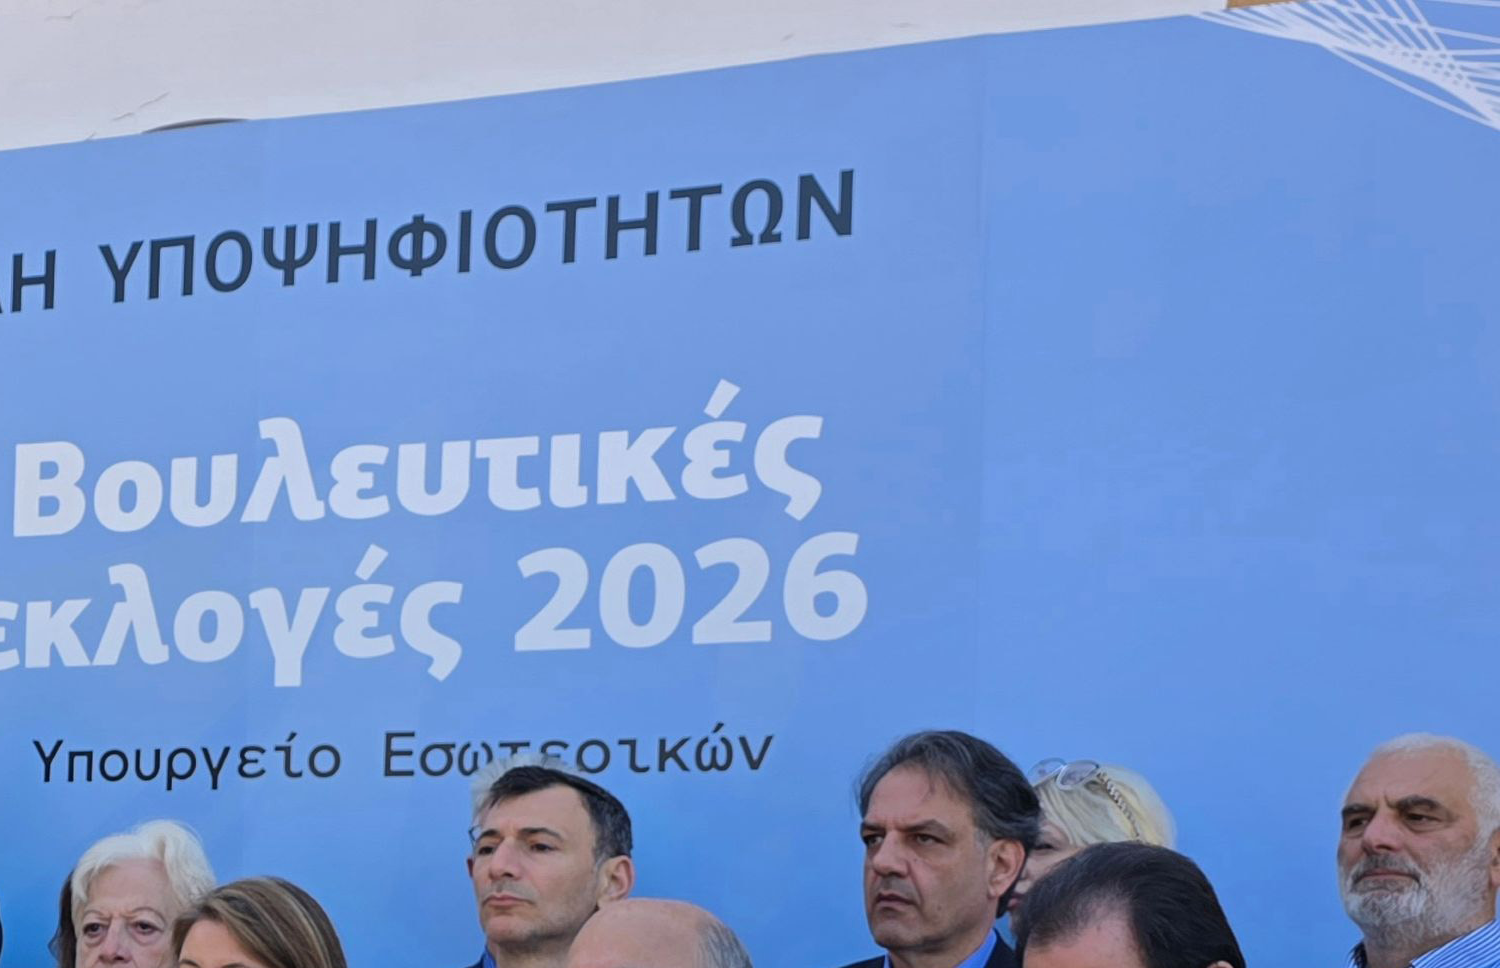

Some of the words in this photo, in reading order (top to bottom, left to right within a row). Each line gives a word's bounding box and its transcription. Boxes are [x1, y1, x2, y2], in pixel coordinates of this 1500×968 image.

[98, 168, 855, 304] ΥΠΟΨΗΦΙΟΤΗΤΩΝ
[13, 379, 823, 537] Βουλευτικές
[514, 531, 868, 652] 2026
[32, 731, 341, 792] Υπουργείο
